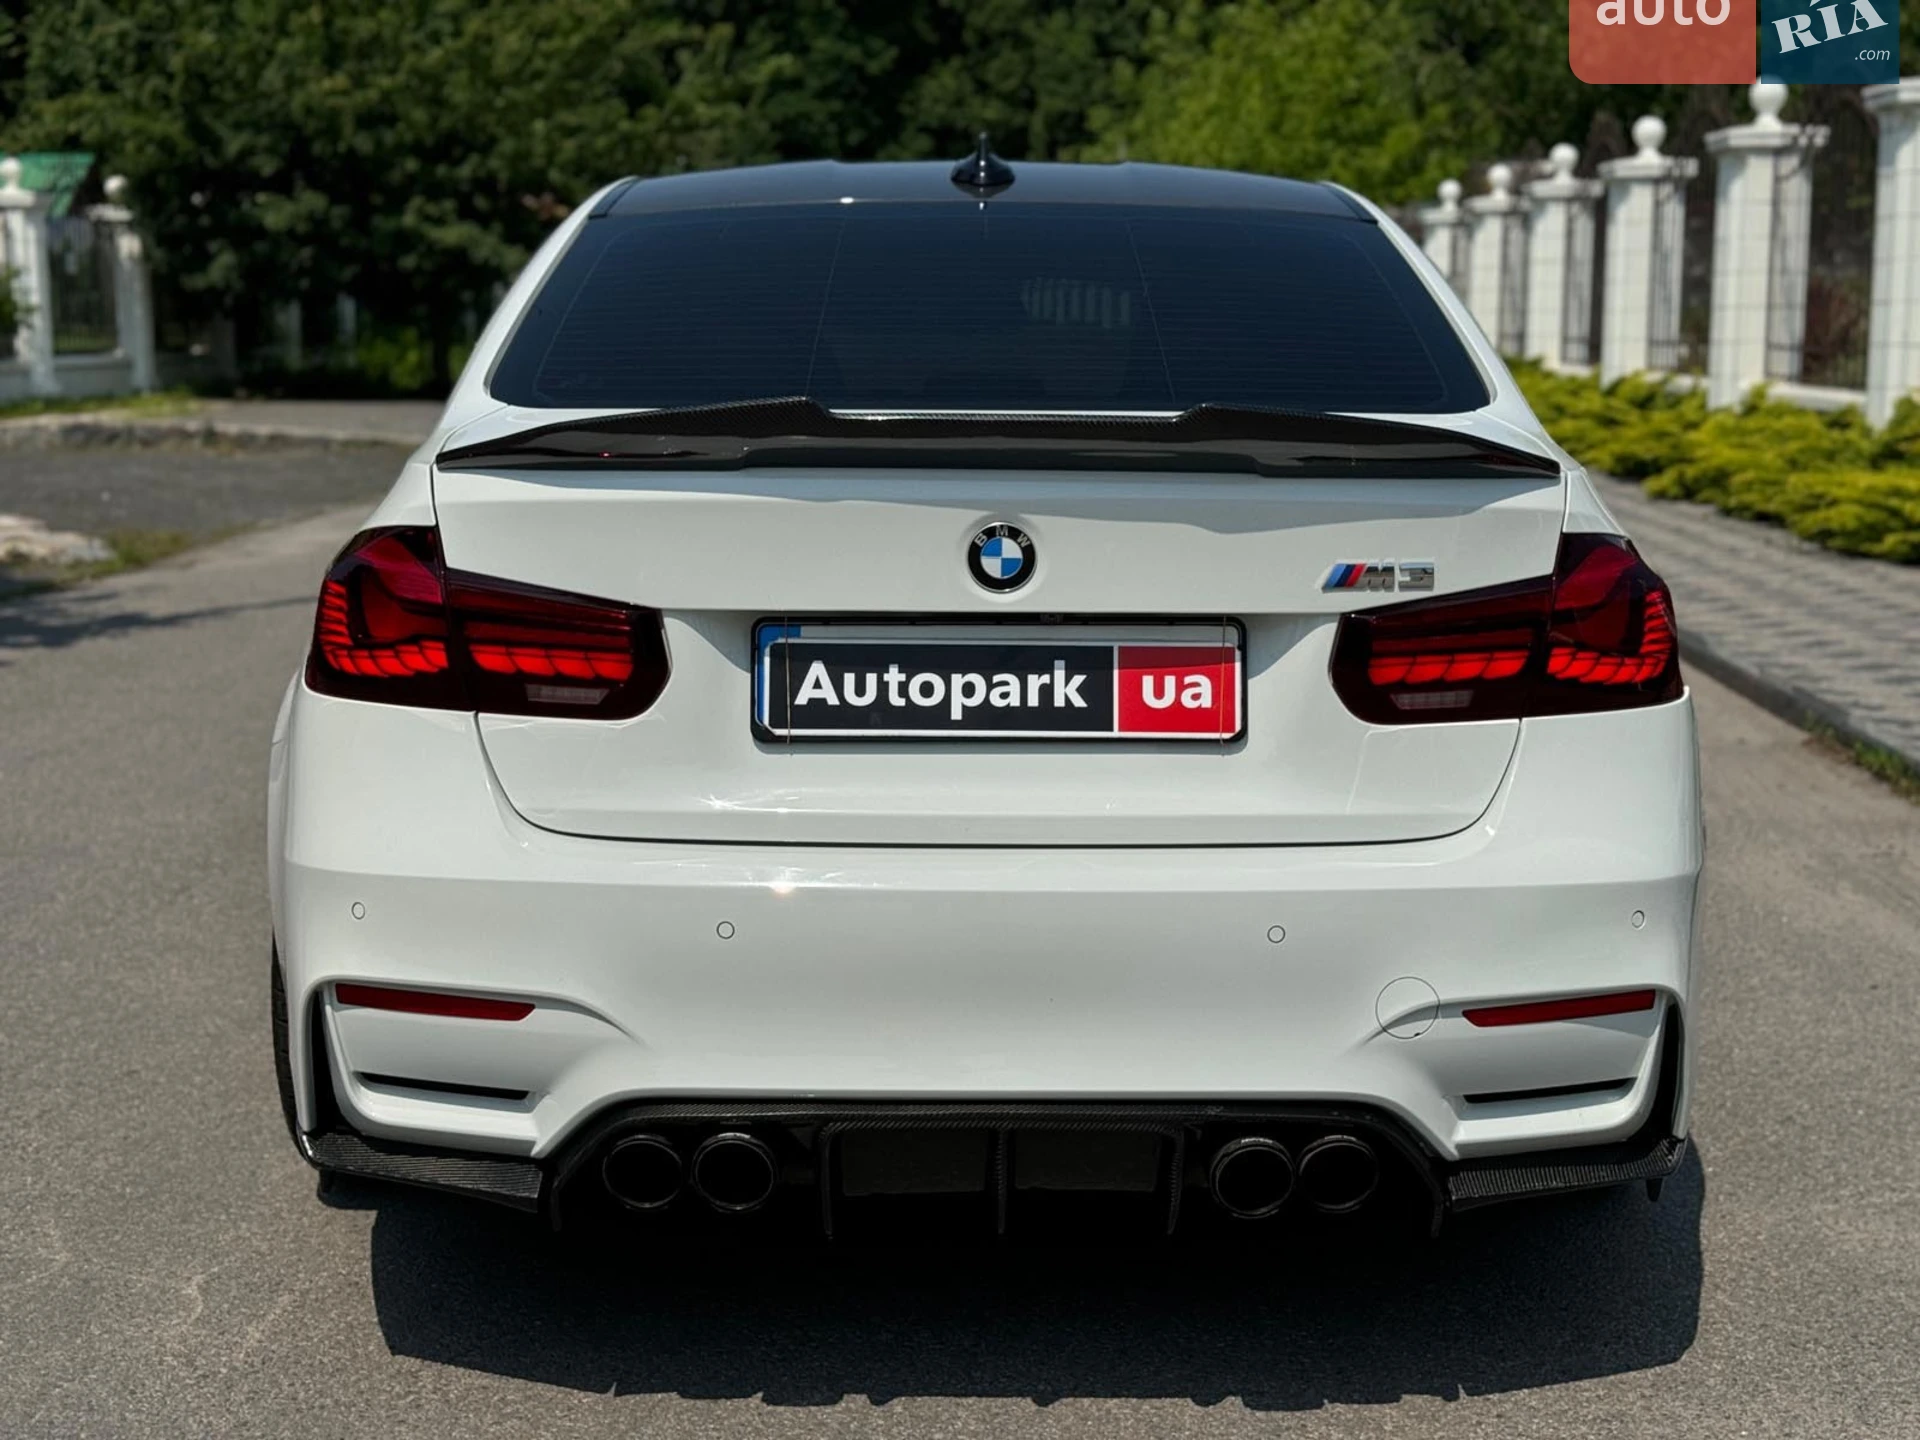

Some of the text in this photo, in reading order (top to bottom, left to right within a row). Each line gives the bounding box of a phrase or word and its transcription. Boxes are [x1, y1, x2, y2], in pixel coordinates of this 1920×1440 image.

[973, 524, 1031, 548] BMW
[1346, 560, 1435, 593] M3
[793, 659, 1213, 721] Autopark ua
